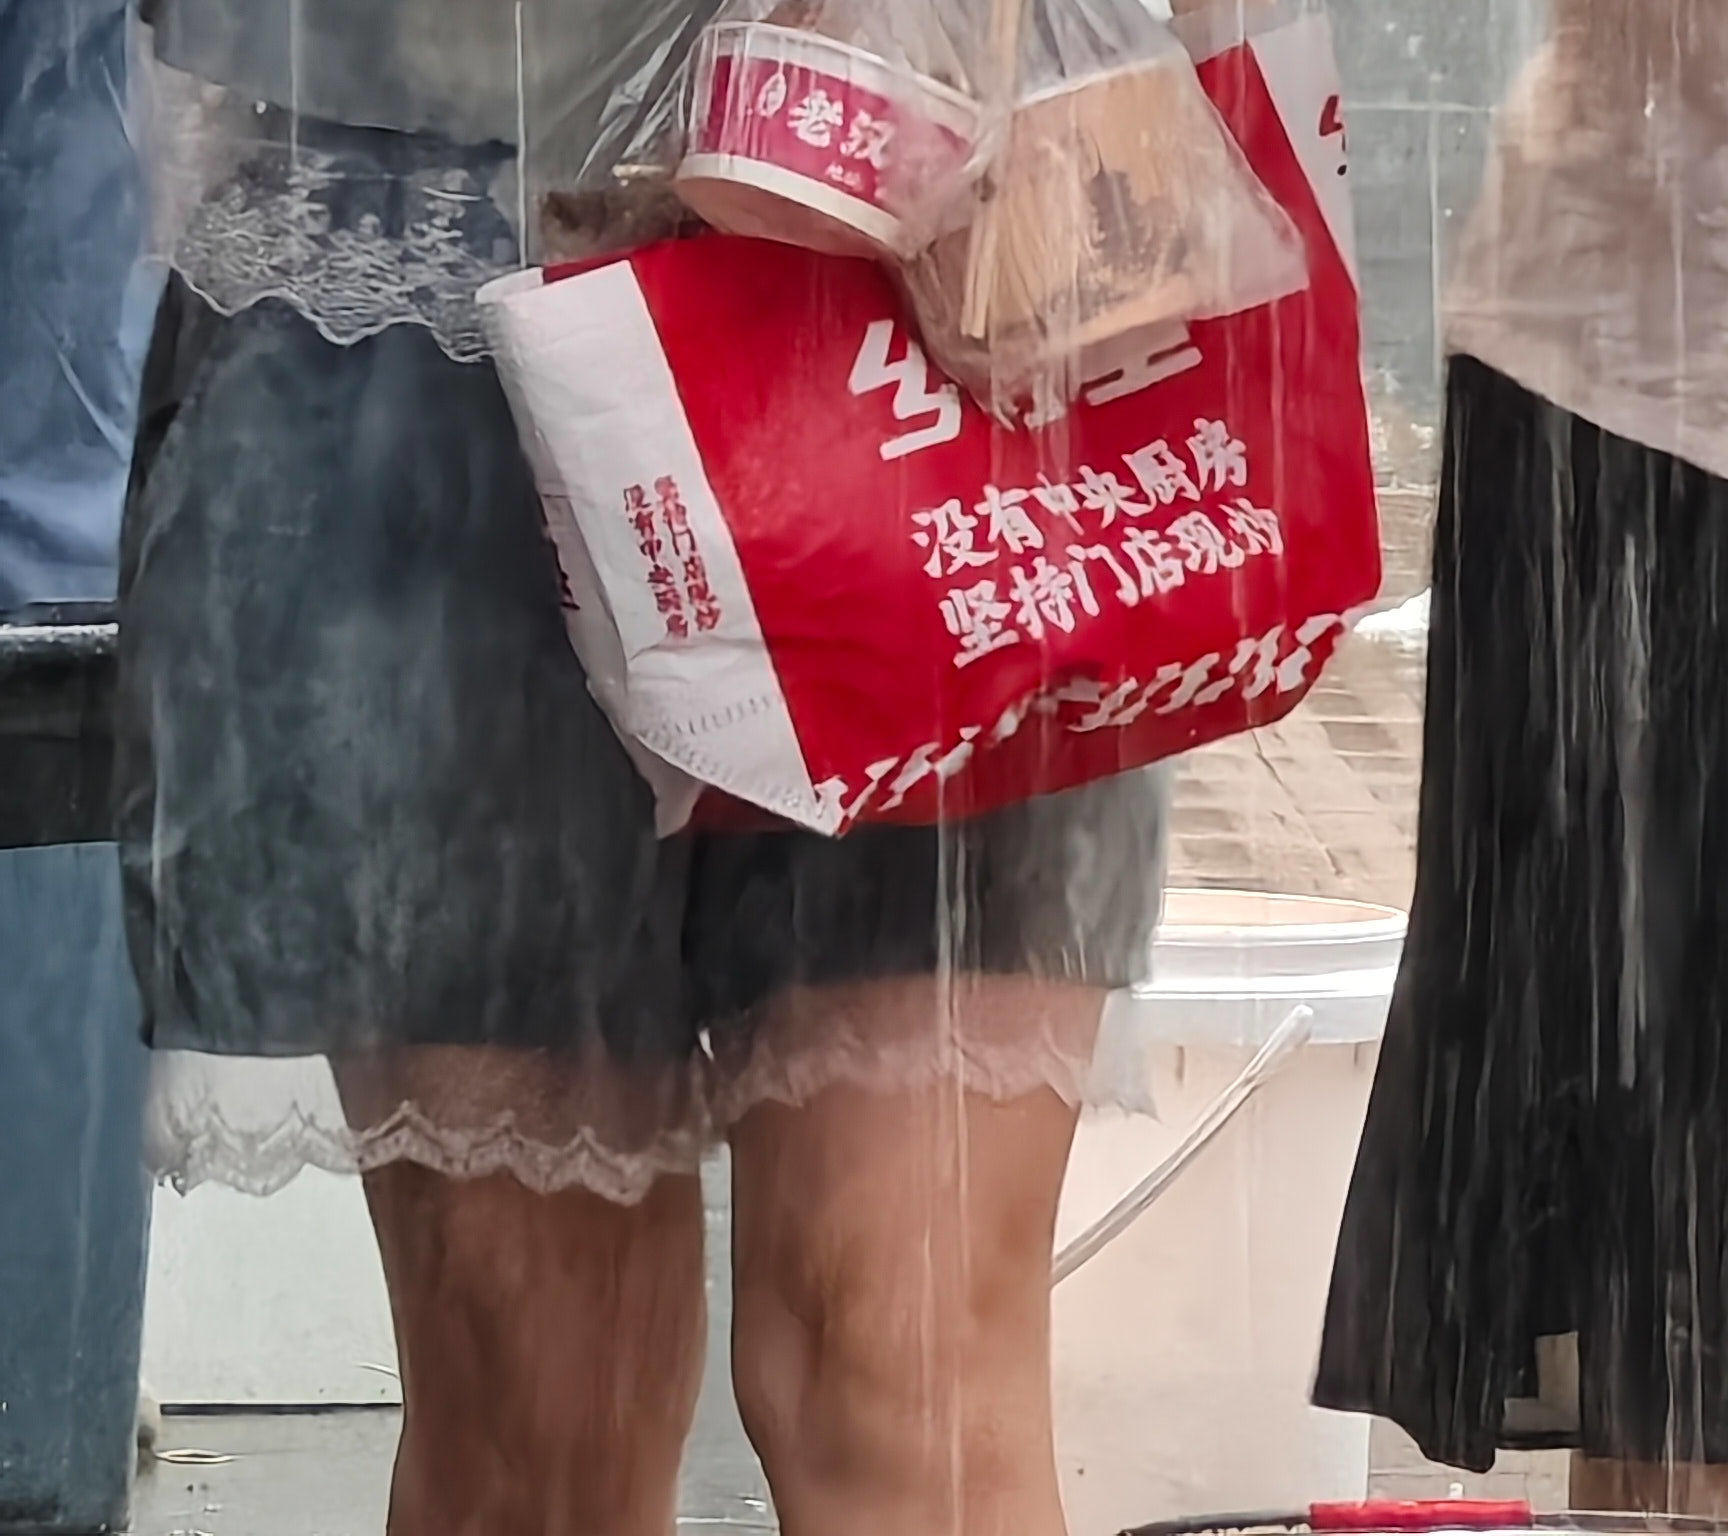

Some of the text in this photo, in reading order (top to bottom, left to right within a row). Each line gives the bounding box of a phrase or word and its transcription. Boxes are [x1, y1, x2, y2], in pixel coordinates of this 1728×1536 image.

[911, 417, 1248, 579] 没有中央厨房
[939, 497, 1286, 668] 坚持门店现炒
